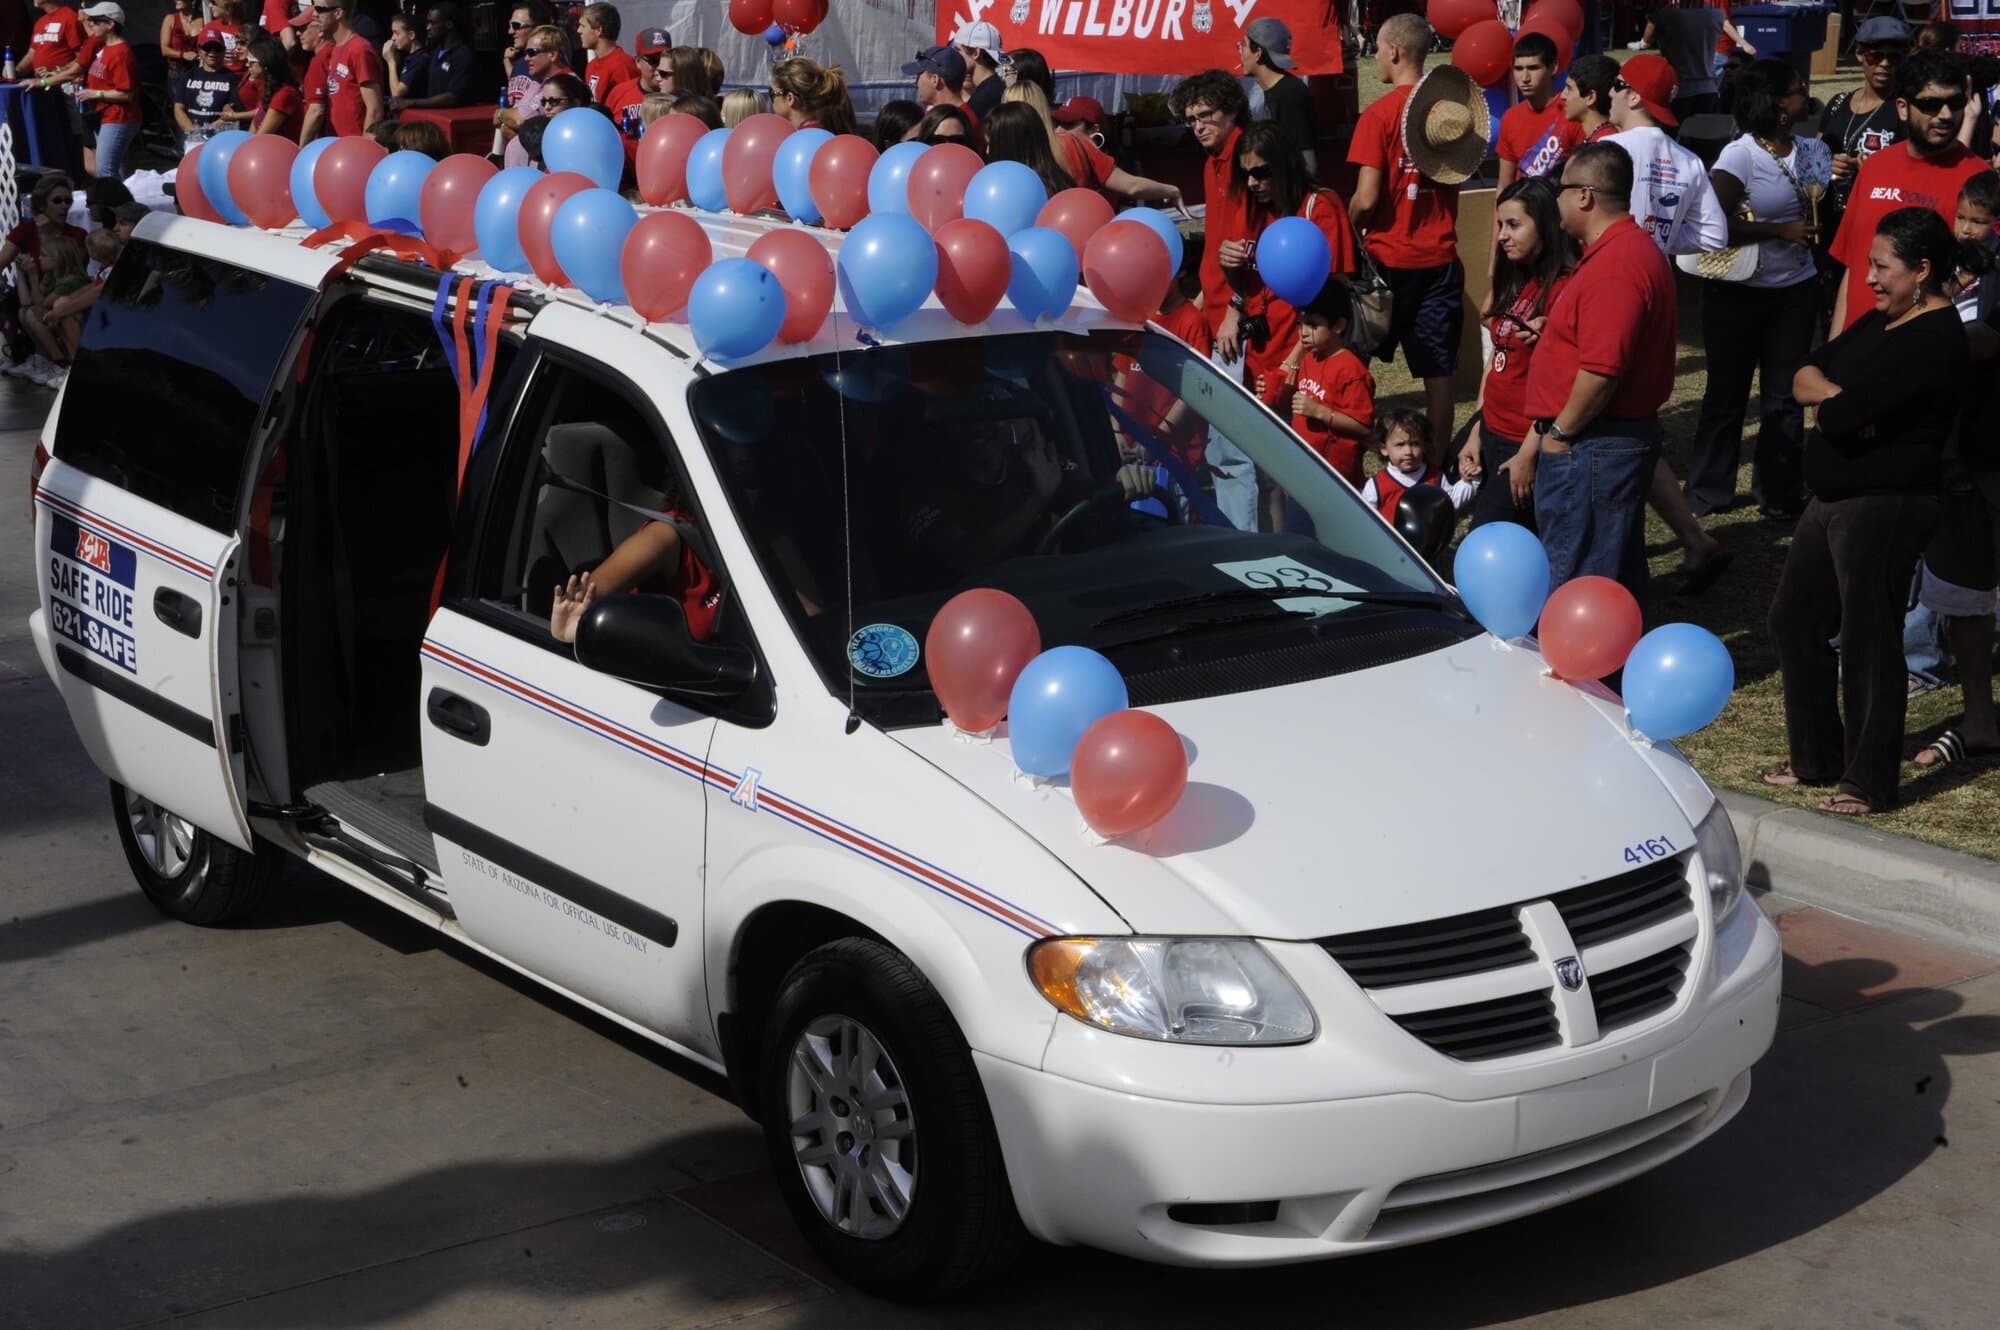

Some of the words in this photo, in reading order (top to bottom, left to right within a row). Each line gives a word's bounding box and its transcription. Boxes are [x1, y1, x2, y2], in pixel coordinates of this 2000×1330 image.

[186, 79, 203, 90] LOS
[203, 81, 231, 92] GATOS
[1870, 187, 1903, 202] BEAR
[50, 557, 90, 606] SAFE
[95, 579, 133, 629] RIDE
[52, 600, 137, 671] 621-SAFE
[730, 766, 762, 813] A
[1624, 835, 1677, 863] 4161
[462, 852, 486, 874] STATE
[488, 866, 499, 881] OF
[502, 872, 541, 901] ARIZONA
[543, 892, 560, 911] FOR
[562, 901, 601, 930] OFFICIAL
[603, 922, 620, 940] USE
[622, 931, 648, 953] ONLY
